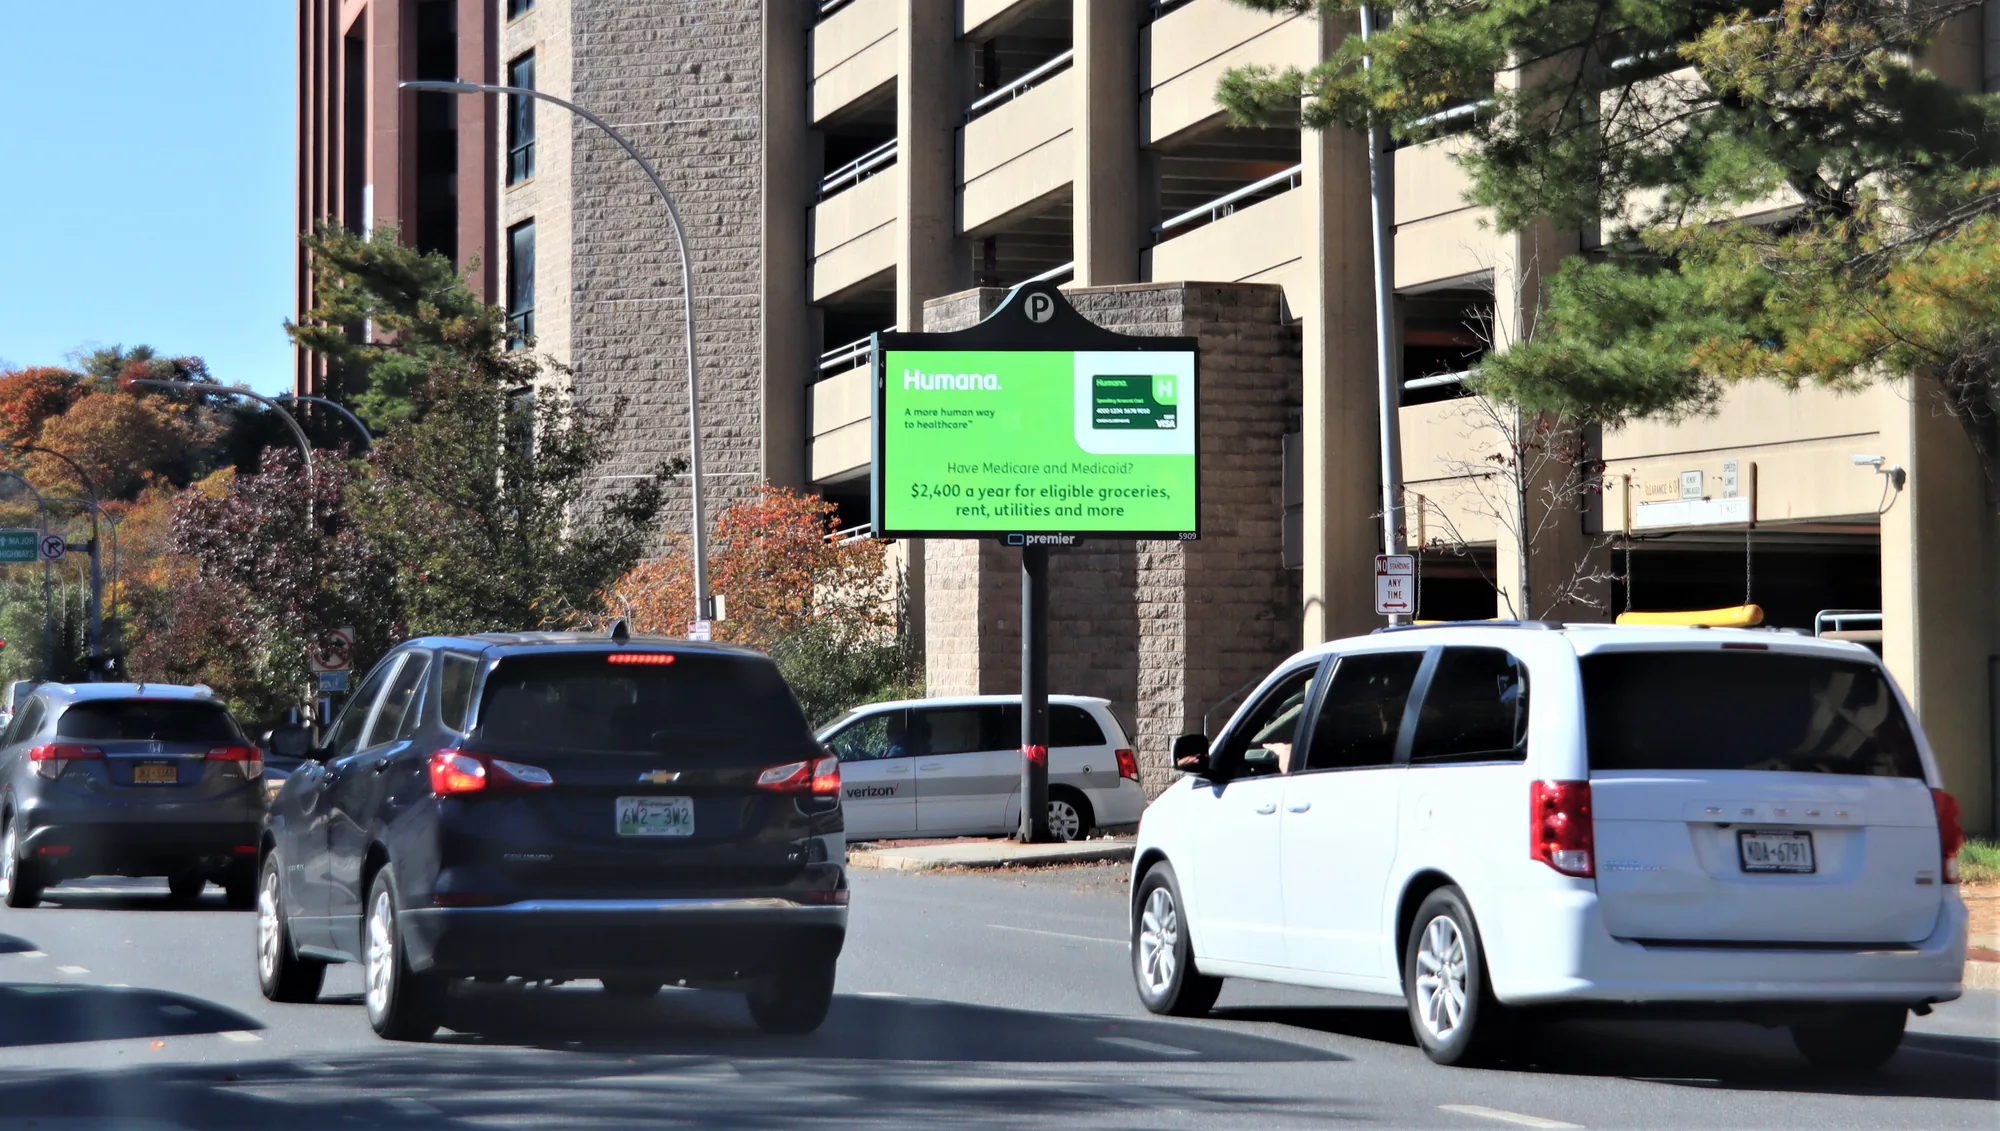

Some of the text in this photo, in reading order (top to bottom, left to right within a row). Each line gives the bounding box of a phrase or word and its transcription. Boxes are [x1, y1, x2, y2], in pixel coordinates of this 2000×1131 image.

[1031, 295, 1050, 321] P
[903, 368, 1003, 391] Humana.
[1157, 379, 1173, 398] H
[904, 407, 996, 420] A more human way
[904, 420, 914, 429] to
[1155, 419, 1176, 428] VISA
[947, 462, 1134, 475] Have Medicare and Medicaid?
[911, 482, 1171, 501] $2,400 a year for eligible groceries,
[956, 503, 1125, 518] rent, utilities and more
[9, 536, 35, 545] MAJOR
[1026, 532, 1076, 547] premier
[1178, 532, 1197, 540] 5909
[1376, 559, 1410, 572] NO STANDING
[1388, 578, 1402, 587] ANY
[1387, 590, 1402, 599] TIME
[846, 786, 895, 798] verizon
[622, 807, 690, 825] 6W2-3W2
